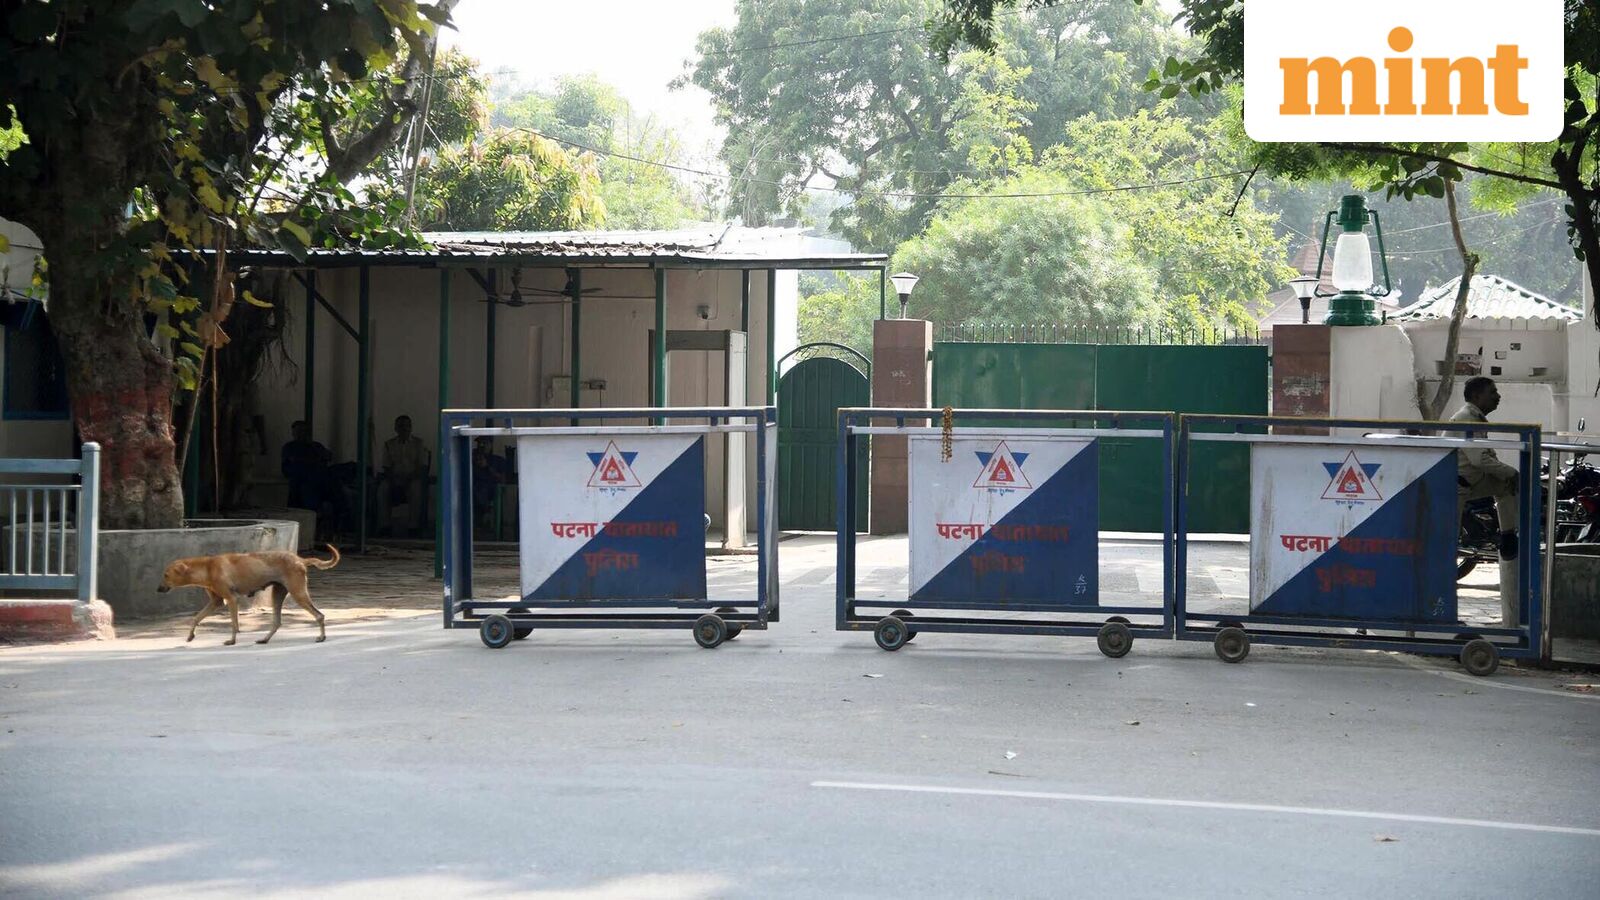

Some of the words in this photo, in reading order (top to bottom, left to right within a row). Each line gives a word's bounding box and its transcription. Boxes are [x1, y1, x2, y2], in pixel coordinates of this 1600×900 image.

[551, 522, 598, 538] पटना
[603, 521, 679, 538] यातायात
[936, 523, 984, 540] पटना
[1280, 534, 1332, 552] पटना
